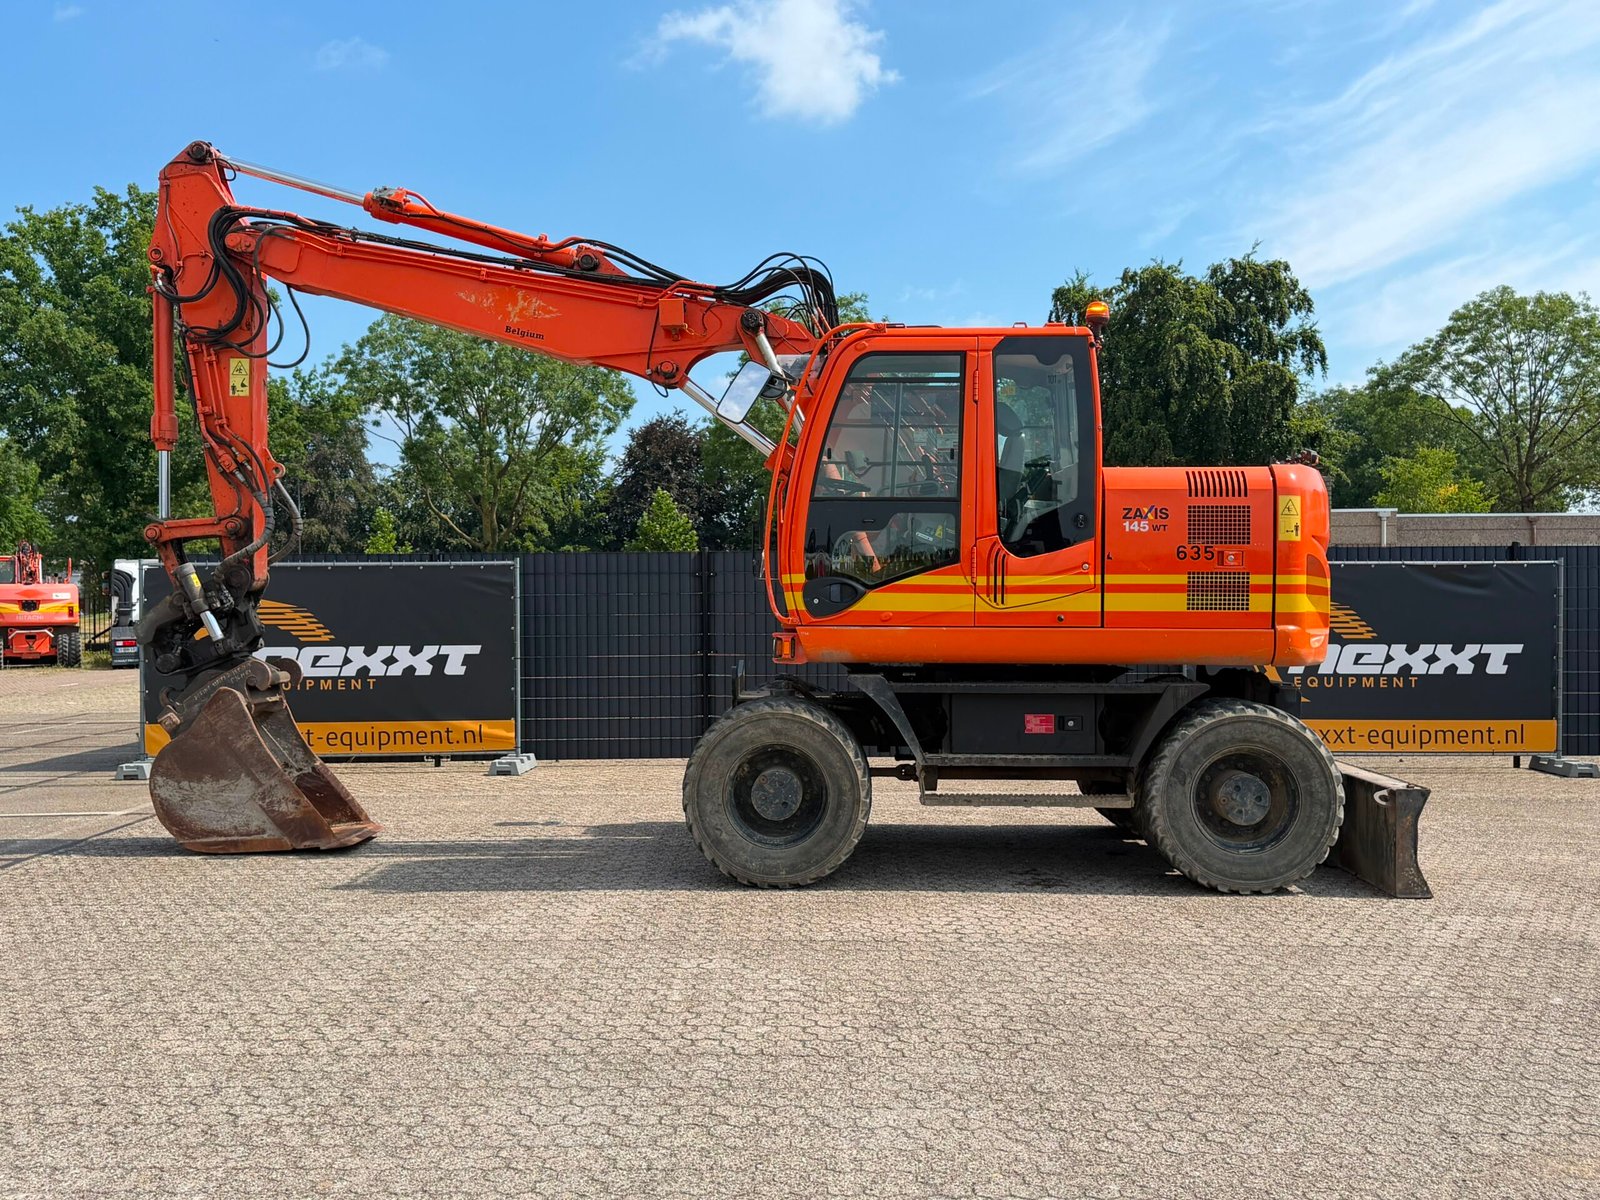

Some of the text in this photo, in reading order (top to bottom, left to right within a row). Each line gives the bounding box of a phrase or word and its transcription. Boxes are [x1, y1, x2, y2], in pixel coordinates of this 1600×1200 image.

[505, 325, 545, 340] Belgium
[1122, 505, 1169, 520] ZAXIS
[1123, 520, 1168, 532] 145 WT
[1176, 545, 1215, 561] 635
[281, 679, 377, 691] UIPMENT
[1293, 676, 1419, 688] EQUIPMENT
[301, 724, 484, 751] t-equipment.nl
[1318, 724, 1526, 749] xxt-equipment.nl
